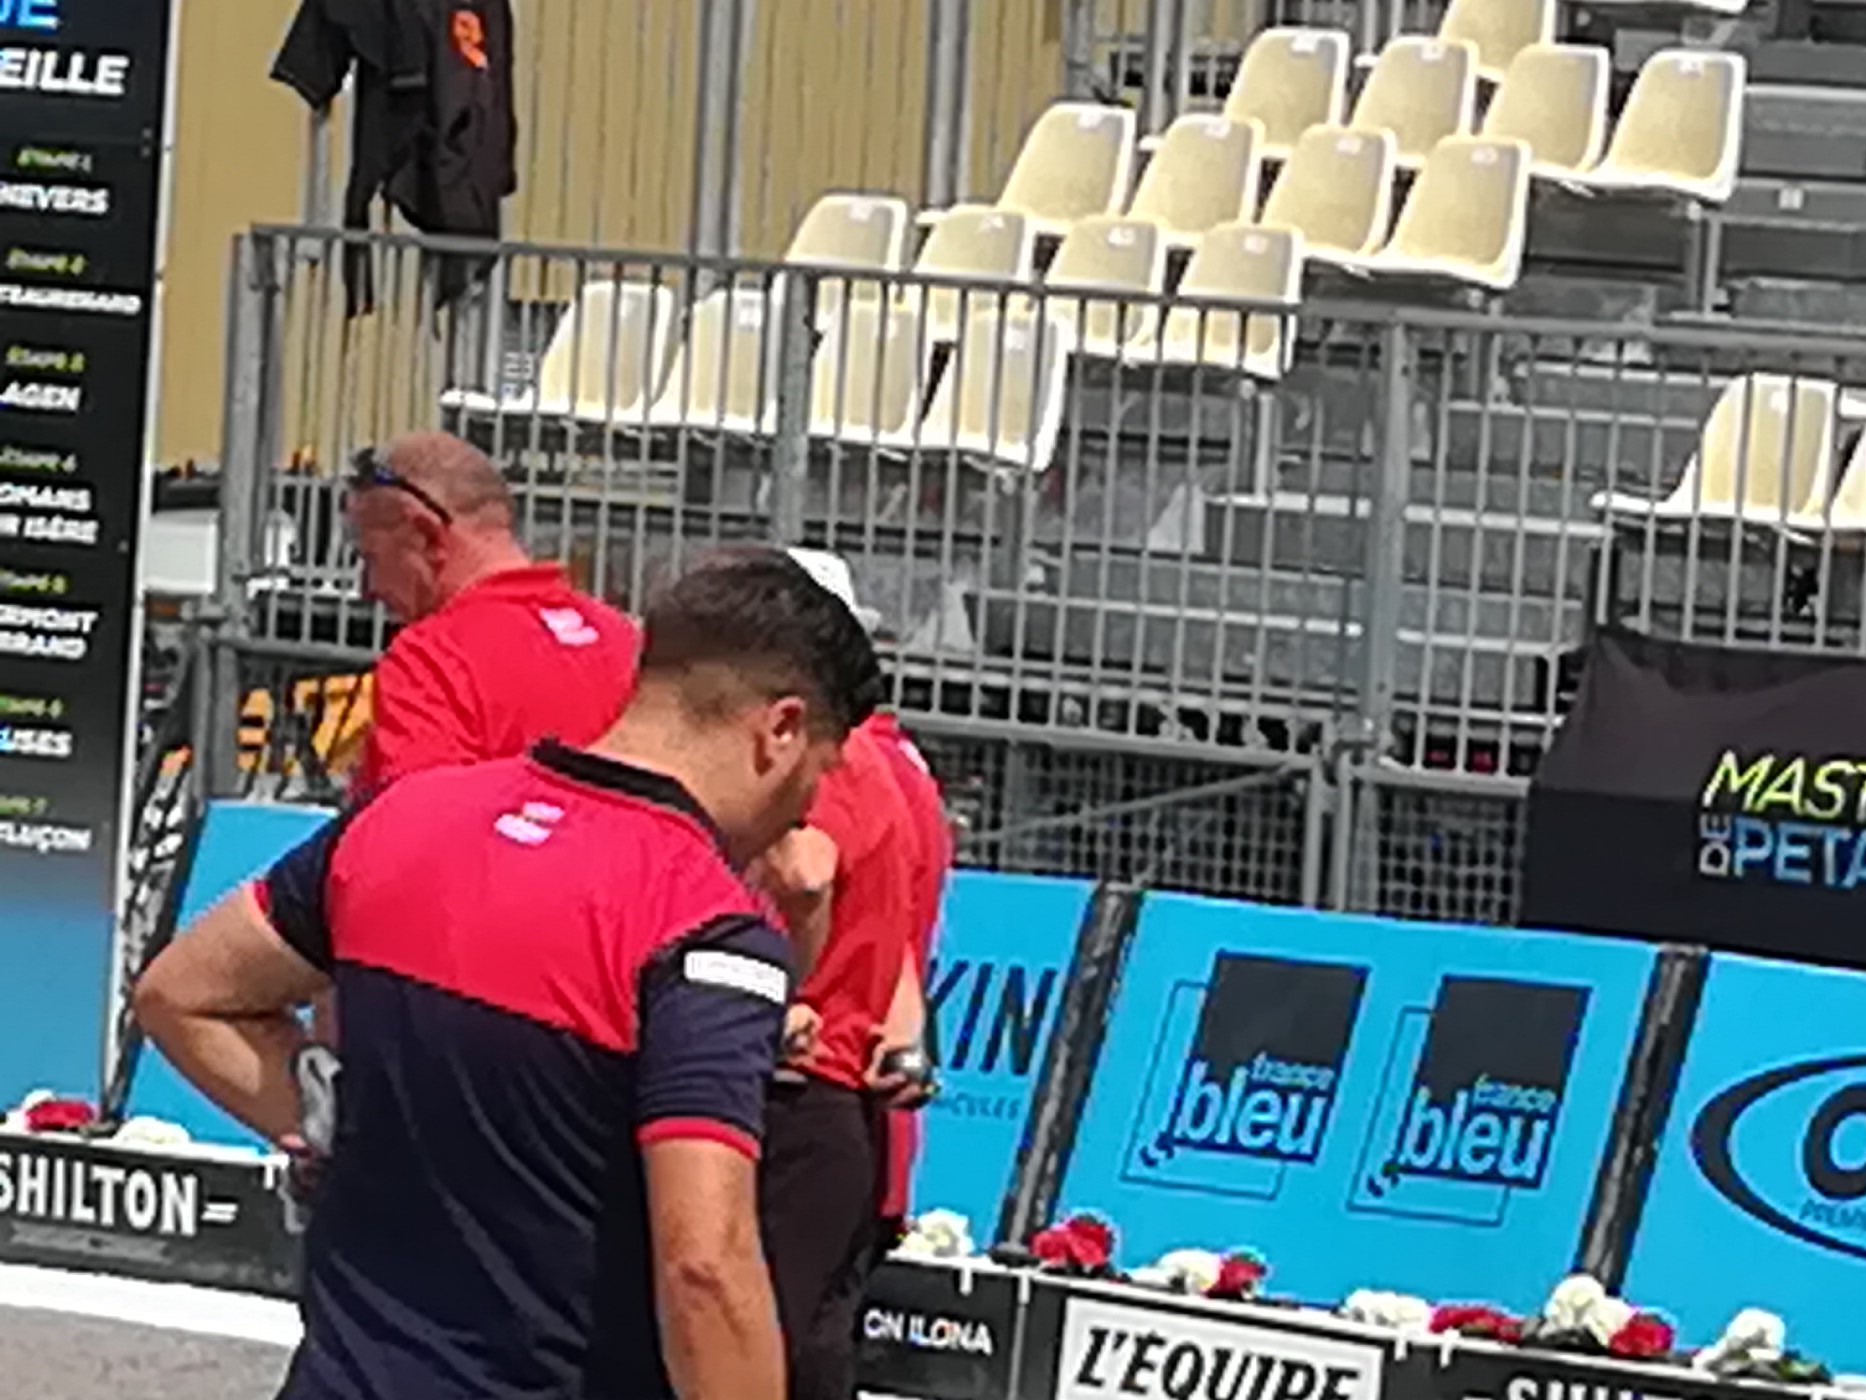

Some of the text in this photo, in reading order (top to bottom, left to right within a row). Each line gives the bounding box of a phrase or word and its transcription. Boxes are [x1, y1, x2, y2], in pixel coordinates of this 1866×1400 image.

[1701, 814, 1732, 876] DE
[1175, 1059, 1327, 1155] bleu
[1403, 1086, 1548, 1178] bleu
[909, 1314, 992, 1356] ILONA
